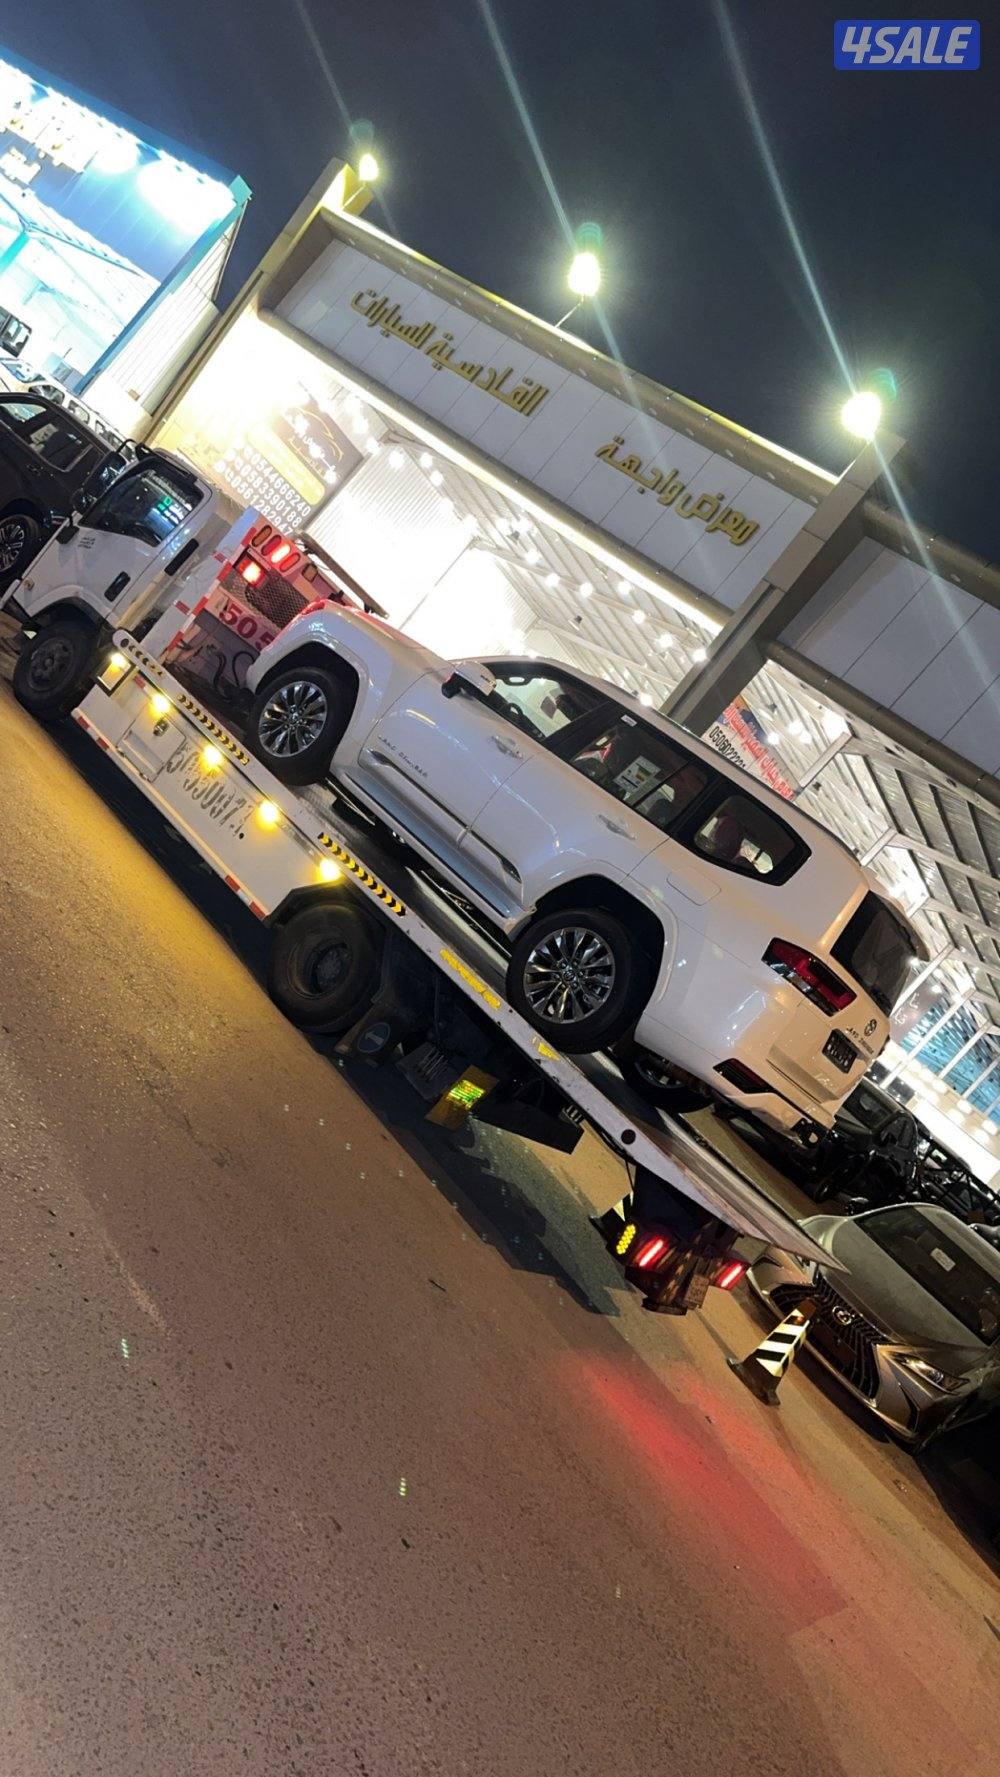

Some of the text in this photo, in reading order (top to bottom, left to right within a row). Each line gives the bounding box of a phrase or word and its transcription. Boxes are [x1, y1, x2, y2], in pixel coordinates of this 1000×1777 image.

[424, 332, 549, 418] القادسية
[240, 463, 302, 528] 0583390188
[251, 452, 312, 517] 0544666240
[595, 435, 686, 507] واجهة
[230, 475, 294, 536] 0561282947
[675, 492, 761, 546] معرض
